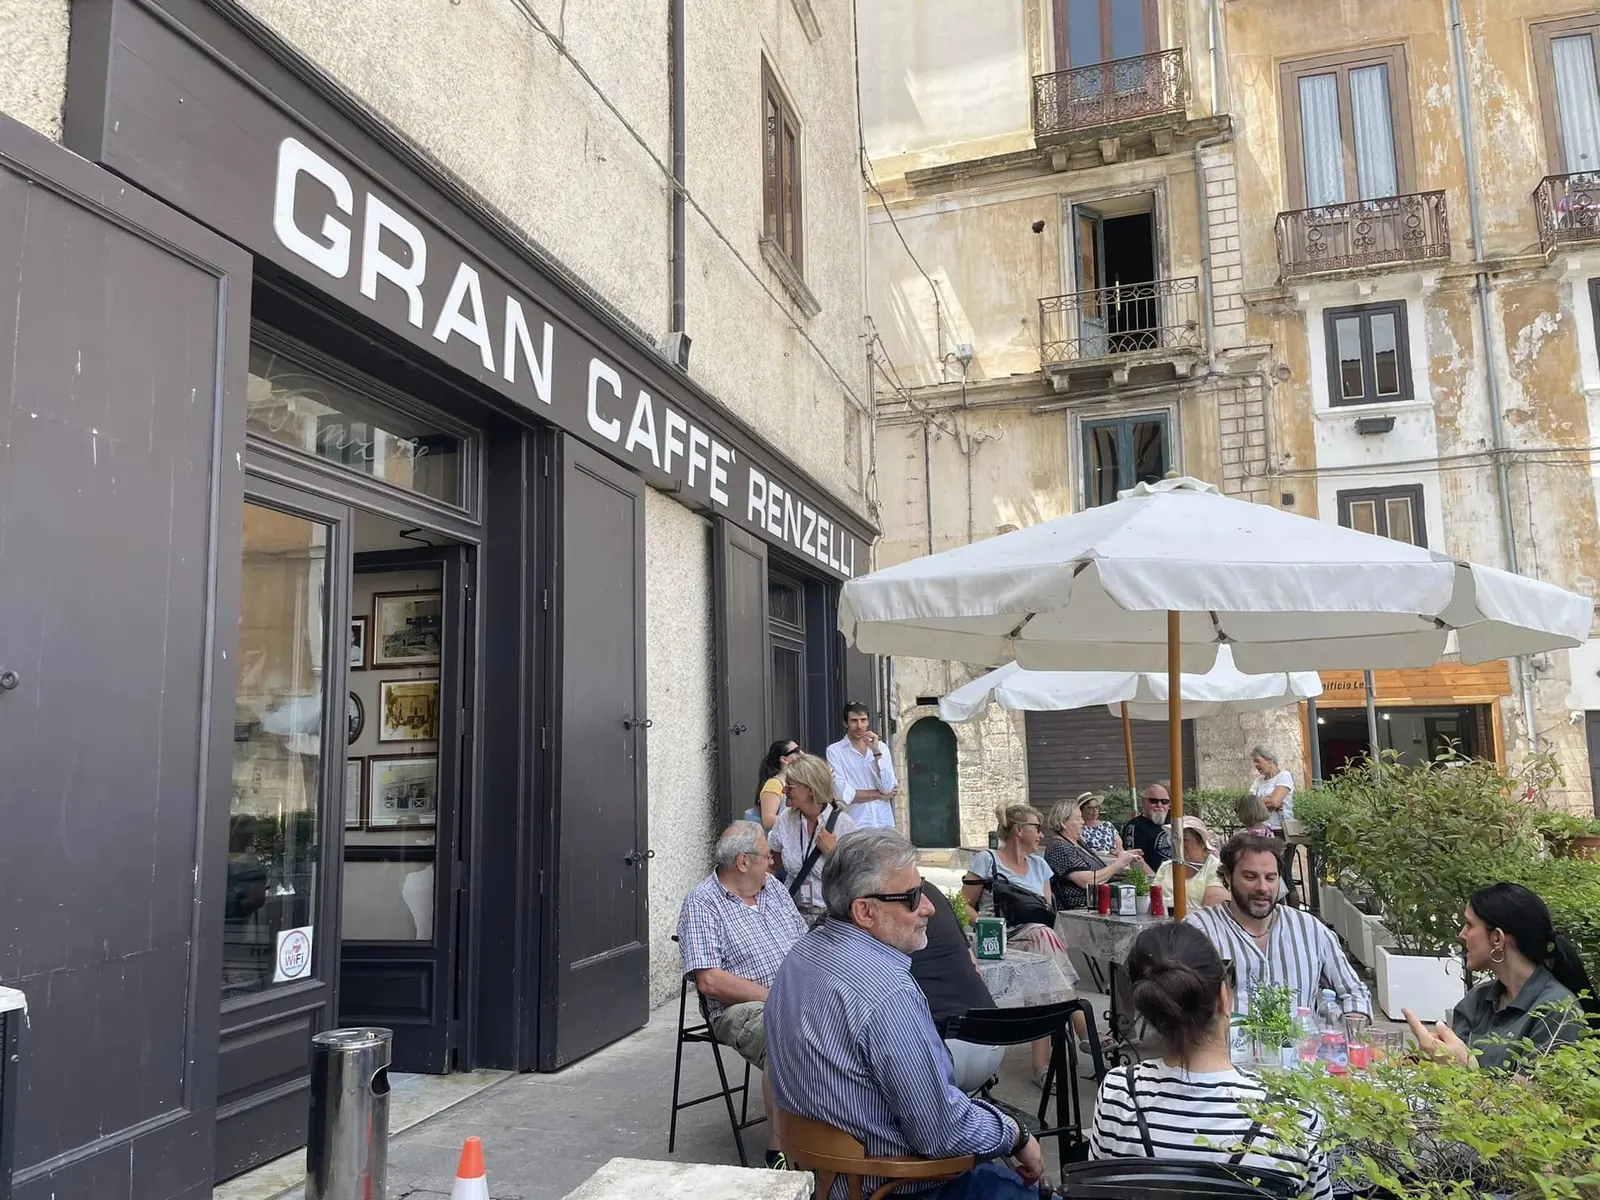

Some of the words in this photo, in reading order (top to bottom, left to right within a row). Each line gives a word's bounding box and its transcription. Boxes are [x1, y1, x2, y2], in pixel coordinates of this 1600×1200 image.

[273, 137, 554, 405] GRAN
[747, 466, 855, 579] RENZELLI
[1322, 681, 1351, 690] nificio
[285, 953, 304, 966] WiFi
